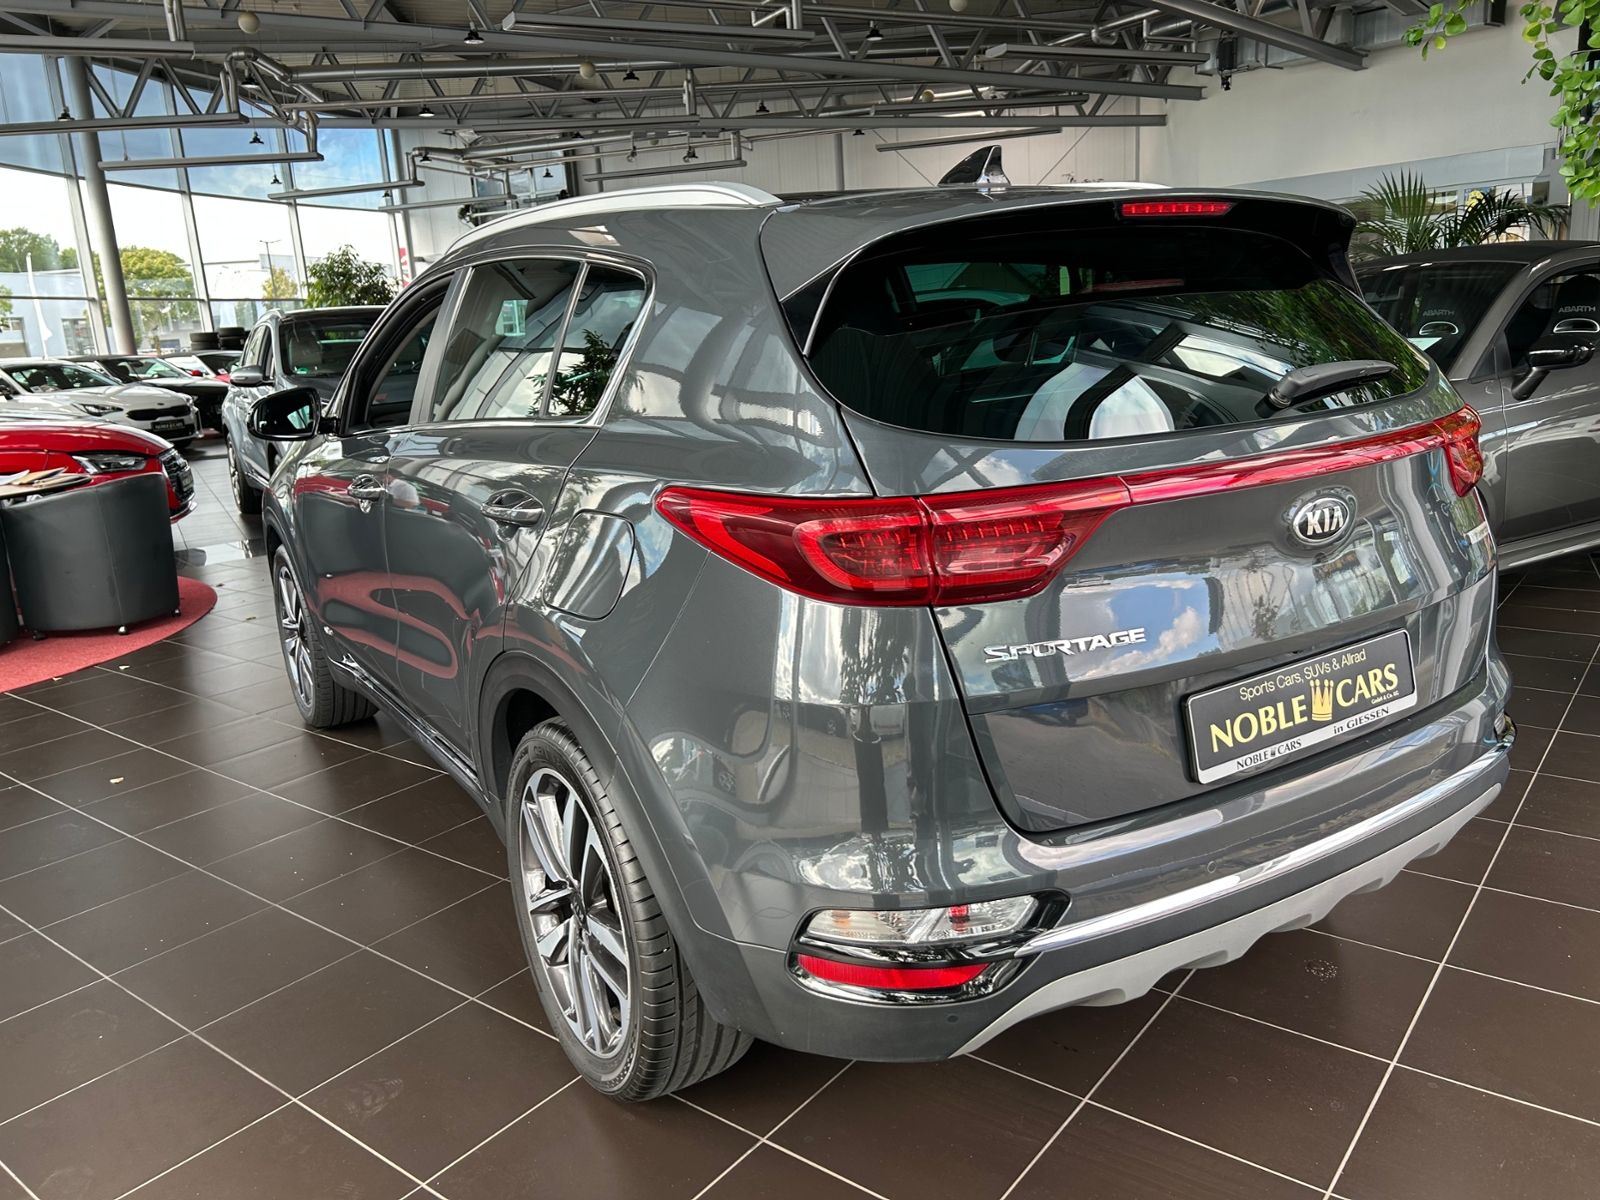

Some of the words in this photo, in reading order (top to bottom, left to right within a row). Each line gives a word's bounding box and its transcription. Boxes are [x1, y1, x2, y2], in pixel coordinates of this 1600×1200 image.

[1422, 308, 1455, 318] ABARTH
[1557, 304, 1597, 314] ABARTH
[1305, 509, 1345, 536] KIA
[984, 628, 1146, 663] SPORTAGE
[1239, 679, 1275, 701] Sports
[1276, 672, 1304, 689] Cars,
[1303, 662, 1331, 681] SUVs
[1332, 658, 1340, 671] &
[1341, 648, 1367, 668] Allrad
[1210, 695, 1309, 753] NOBLE
[1335, 663, 1399, 708] CARS
[1333, 724, 1345, 735] in
[1346, 706, 1390, 730] GIESSEN
[1235, 750, 1269, 771] NOBLE
[1277, 738, 1303, 755] CARS
